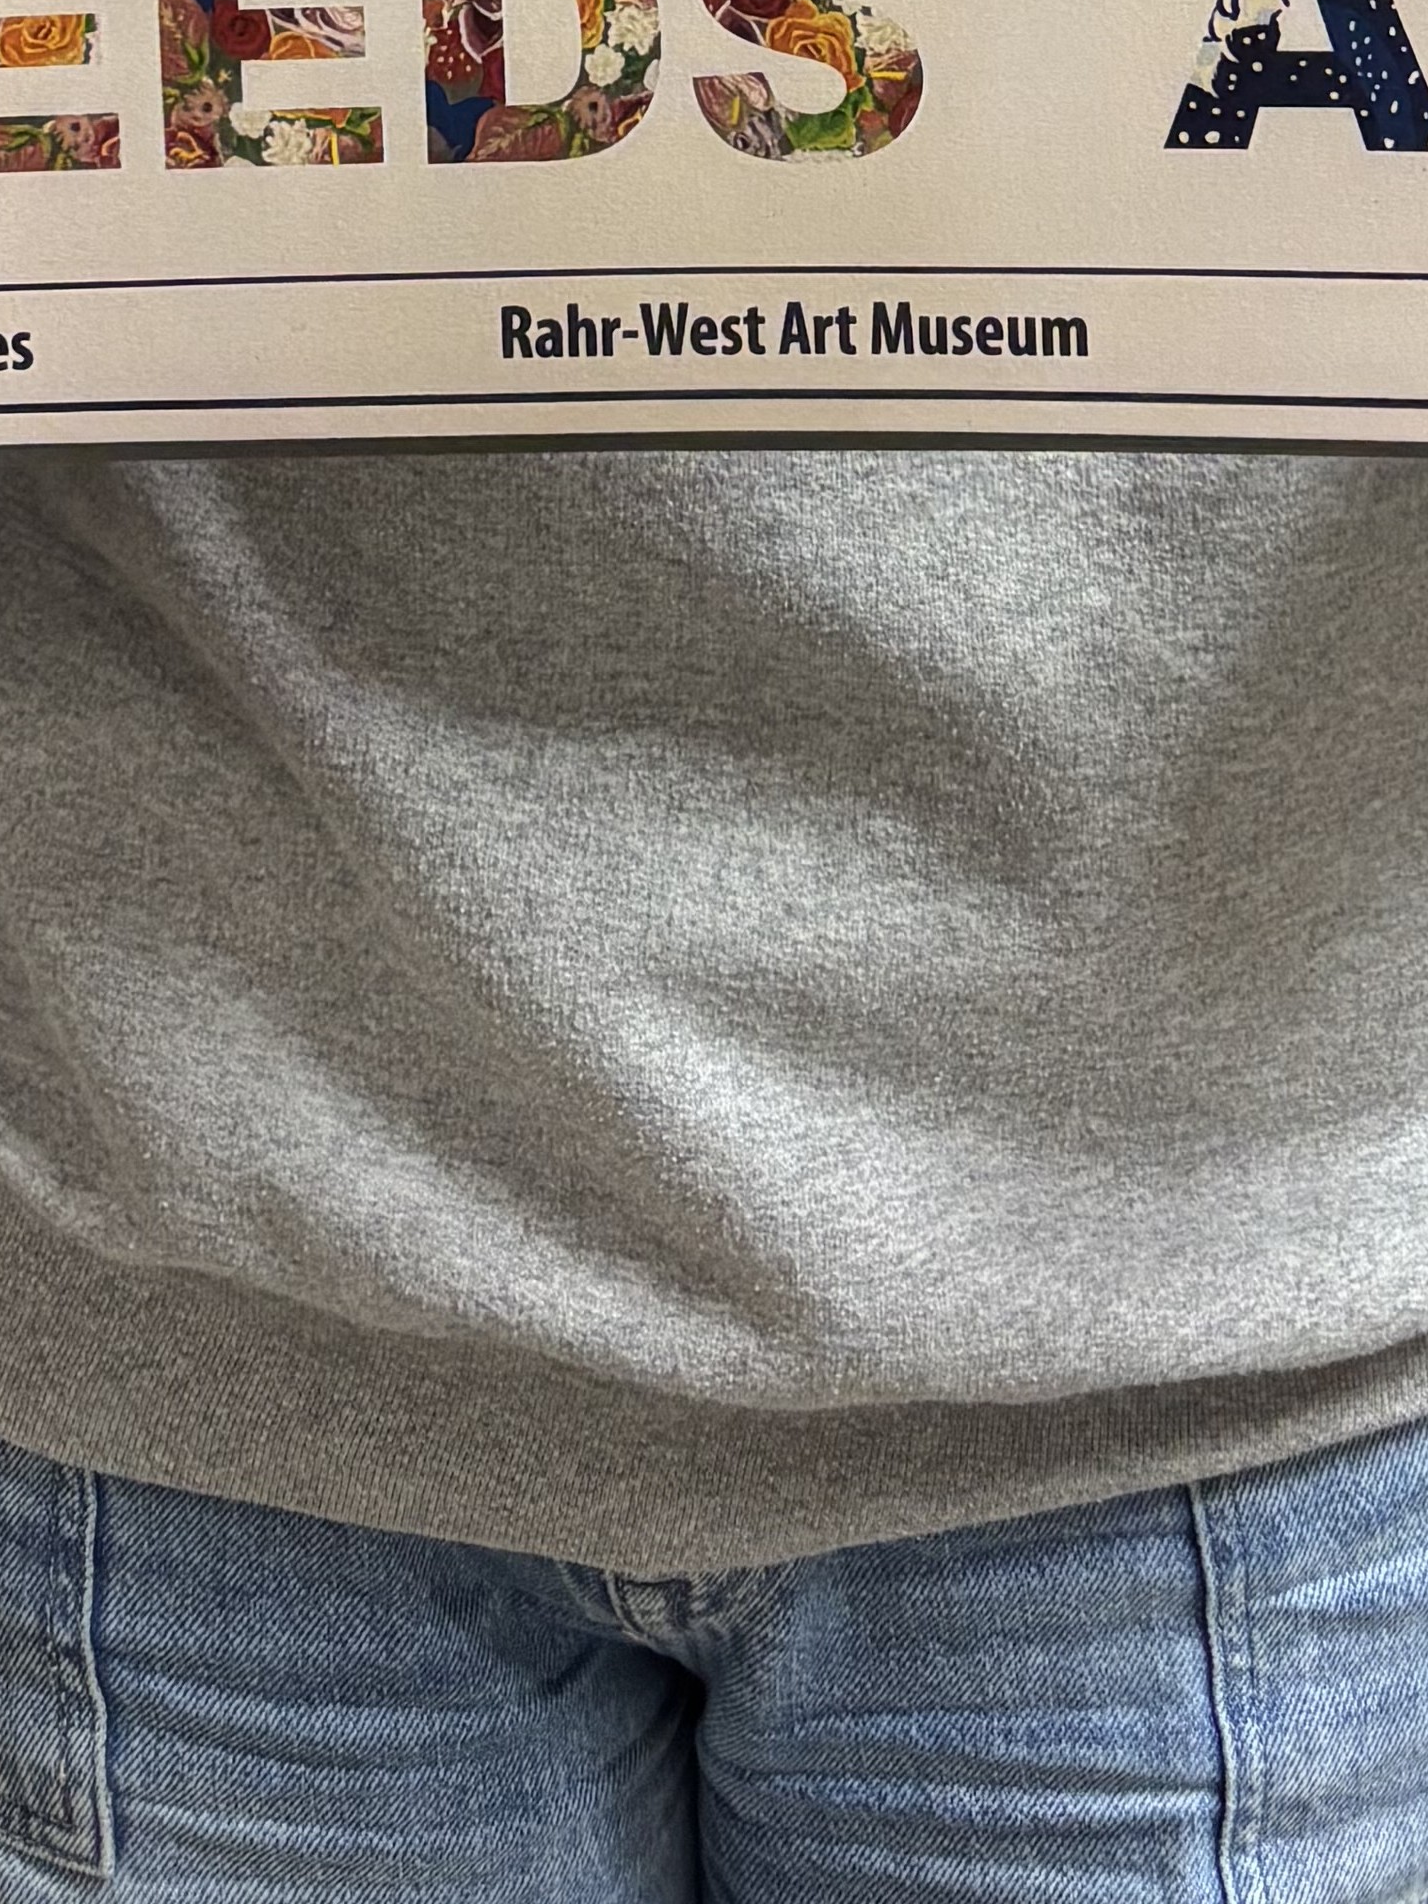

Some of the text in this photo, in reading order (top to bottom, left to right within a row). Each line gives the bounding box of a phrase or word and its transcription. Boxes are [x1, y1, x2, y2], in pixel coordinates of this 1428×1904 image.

[500, 301, 1089, 358] Rahr-West Art Museum
